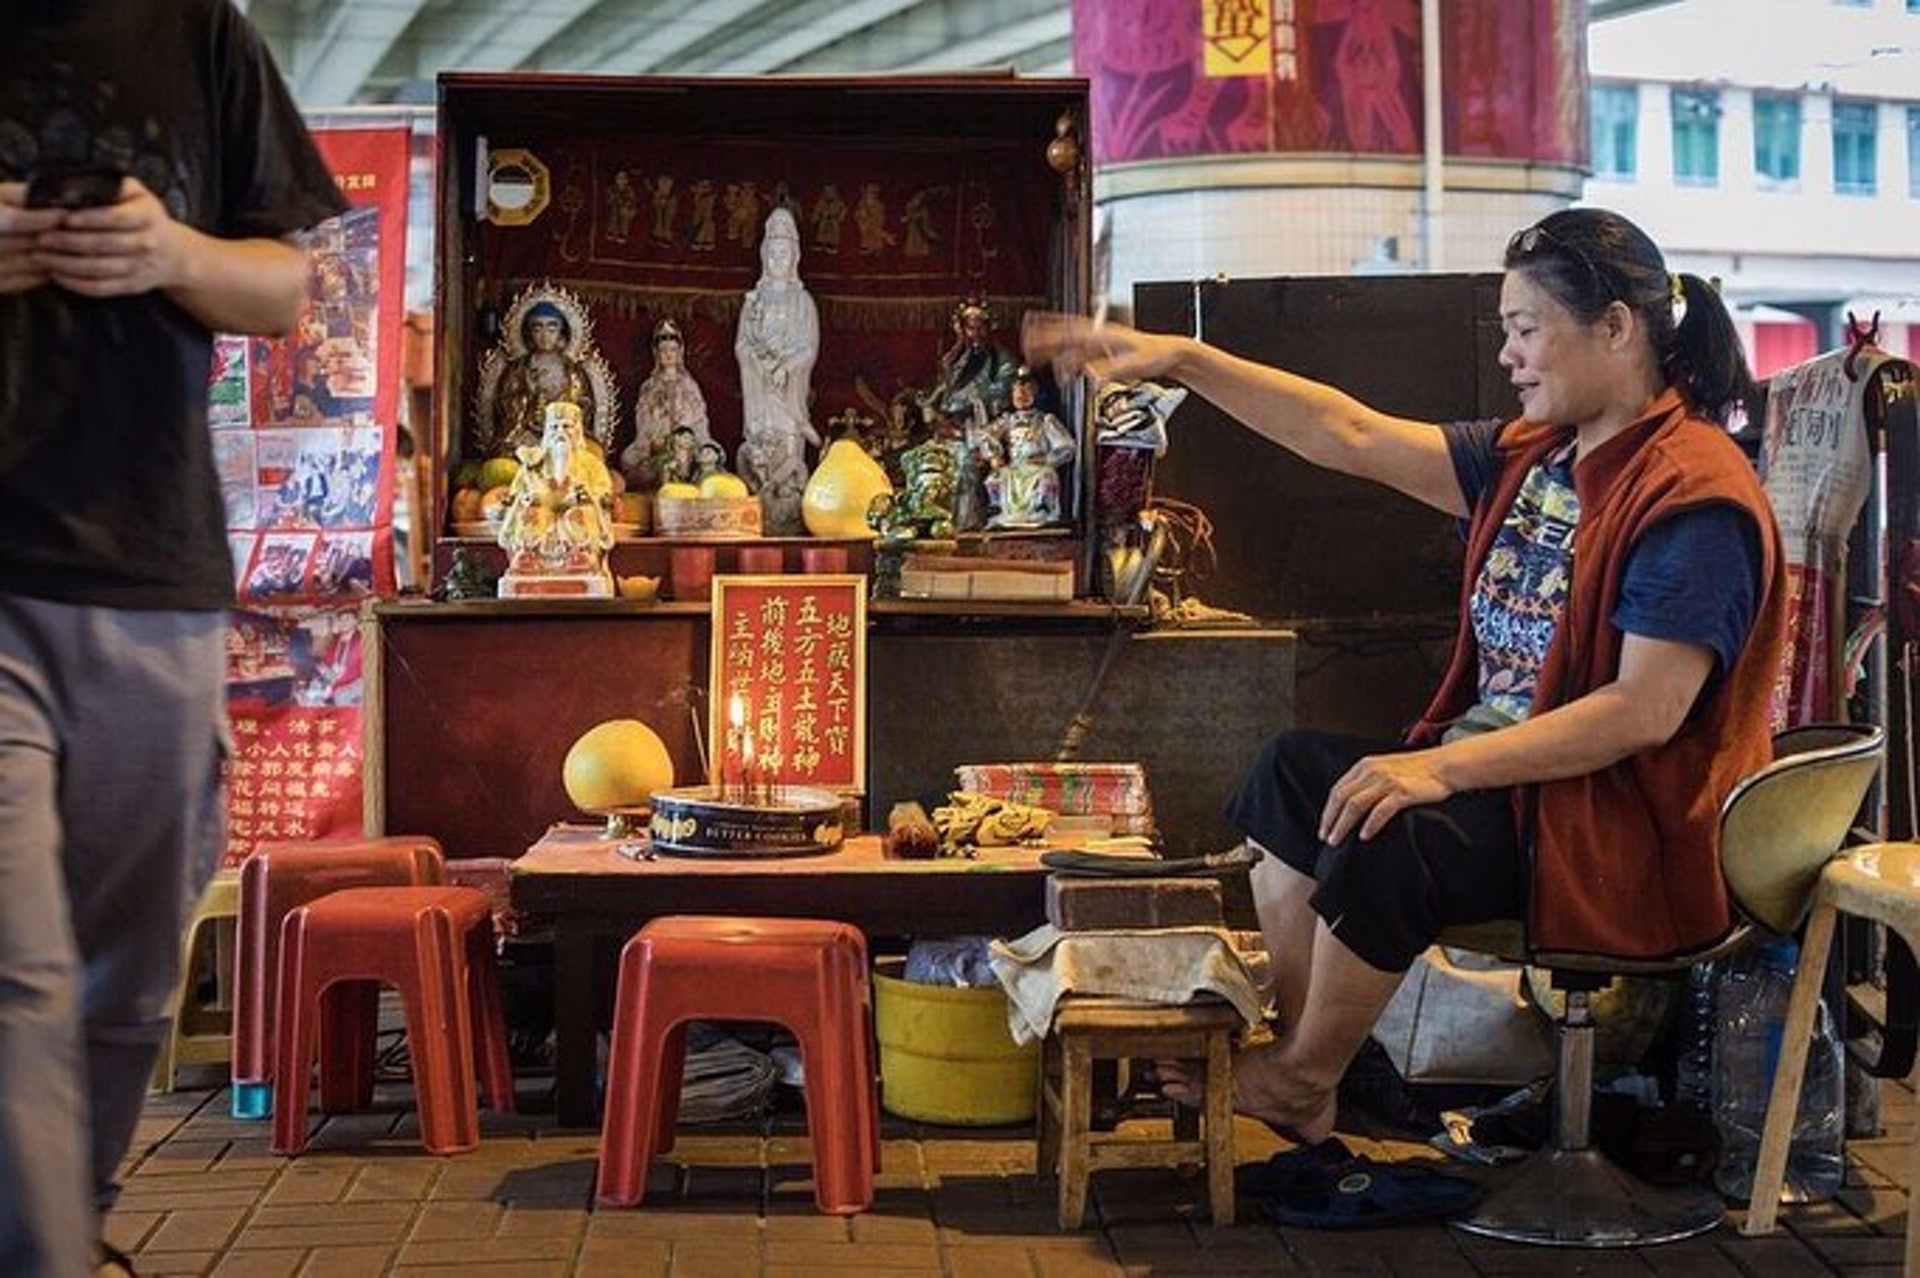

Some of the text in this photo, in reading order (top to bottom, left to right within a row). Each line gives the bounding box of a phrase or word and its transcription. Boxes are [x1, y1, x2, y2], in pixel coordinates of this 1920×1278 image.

[793, 596, 823, 776] 五方五土龍神
